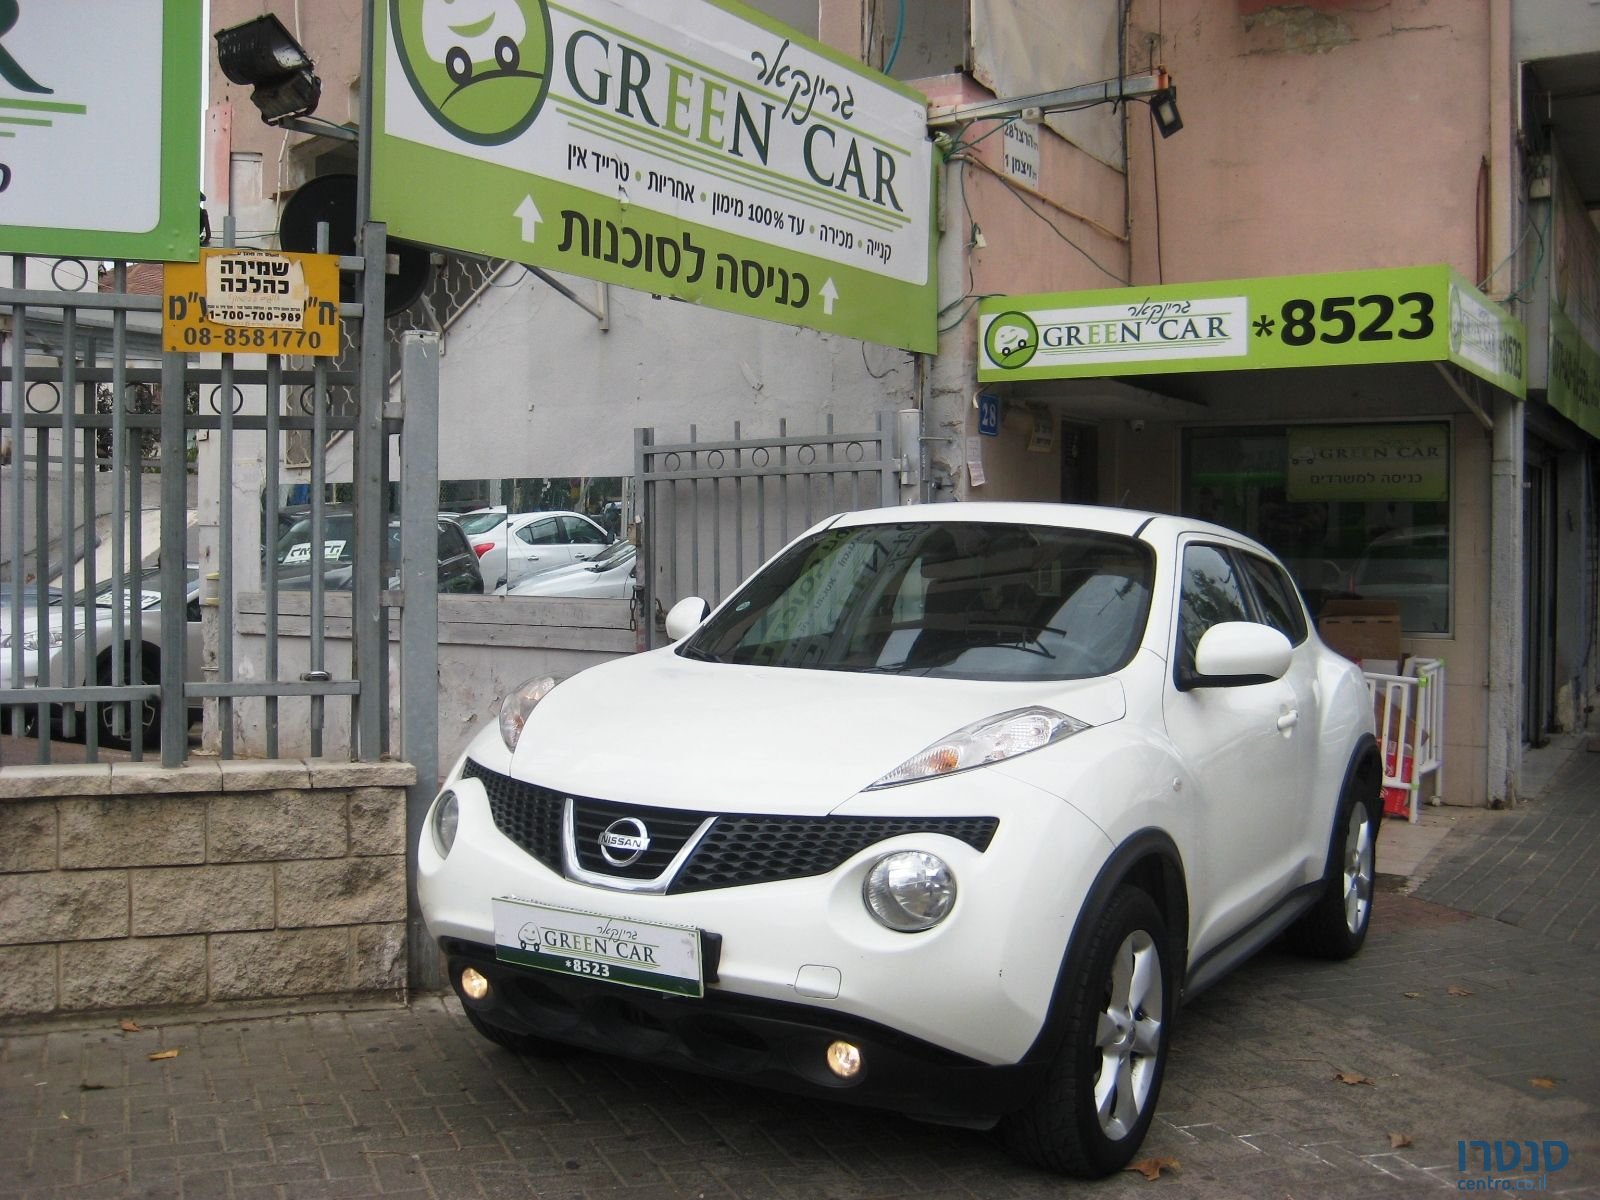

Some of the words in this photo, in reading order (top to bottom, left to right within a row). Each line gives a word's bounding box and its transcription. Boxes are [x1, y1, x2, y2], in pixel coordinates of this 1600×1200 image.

[565, 29, 775, 166] GREEN
[803, 124, 904, 212] CAR
[567, 143, 588, 170] אין
[592, 151, 630, 182] טרייד
[648, 171, 695, 203] אחריות
[712, 192, 743, 218] מימון
[748, 204, 784, 230] 100%
[787, 214, 805, 236] עד
[819, 224, 853, 249] מכירה
[557, 209, 706, 283] לסוכנות
[867, 239, 892, 264] קנייה
[220, 259, 290, 277] שמירה
[220, 276, 290, 295] כהלכה
[715, 253, 810, 309] כניסה
[208, 310, 302, 323] 1-700-700-989
[184, 327, 321, 349] 08-8581770
[1043, 320, 1142, 347] GREEN
[1158, 316, 1229, 341] CAR
[982, 402, 997, 427] 28
[1319, 447, 1388, 460] GREEN
[1398, 446, 1440, 458] CAR
[1310, 472, 1375, 485] למשרדים
[1381, 473, 1423, 484] כניסה
[600, 834, 643, 848] NISSAN
[544, 930, 607, 954] GREEN
[616, 942, 657, 963] CAR
